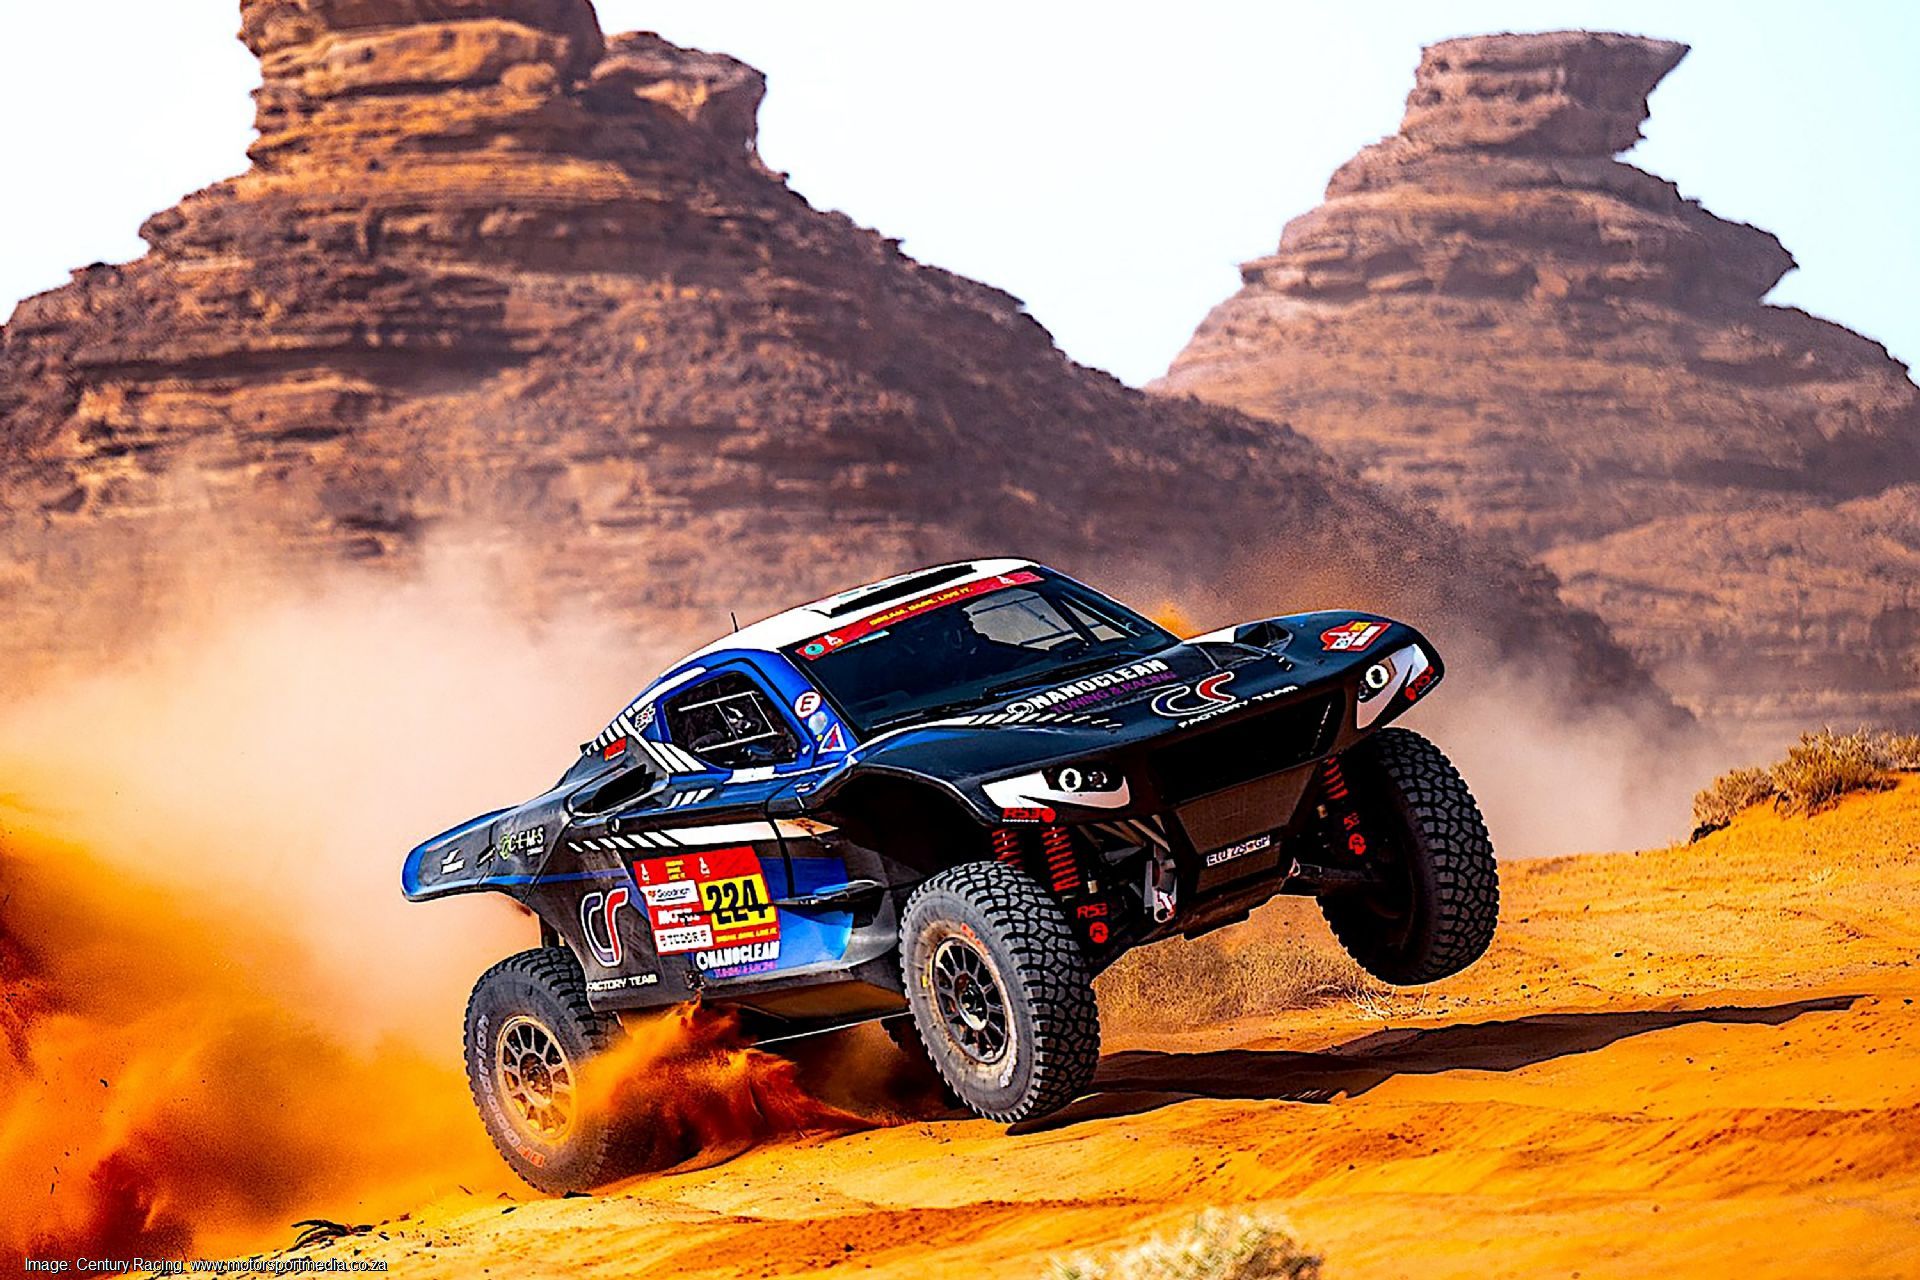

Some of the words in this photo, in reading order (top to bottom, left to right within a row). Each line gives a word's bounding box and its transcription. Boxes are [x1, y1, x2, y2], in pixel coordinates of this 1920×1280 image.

[800, 695, 815, 712] E
[1027, 659, 1168, 709] NANOCLEAN
[1050, 690, 1109, 714] TUNING
[1122, 670, 1178, 691] RACING
[1178, 700, 1248, 728] FACTORY
[1252, 685, 1298, 701] TEAM
[706, 879, 769, 925] 224
[586, 977, 627, 992] FACTORY
[628, 973, 658, 986] TEAM
